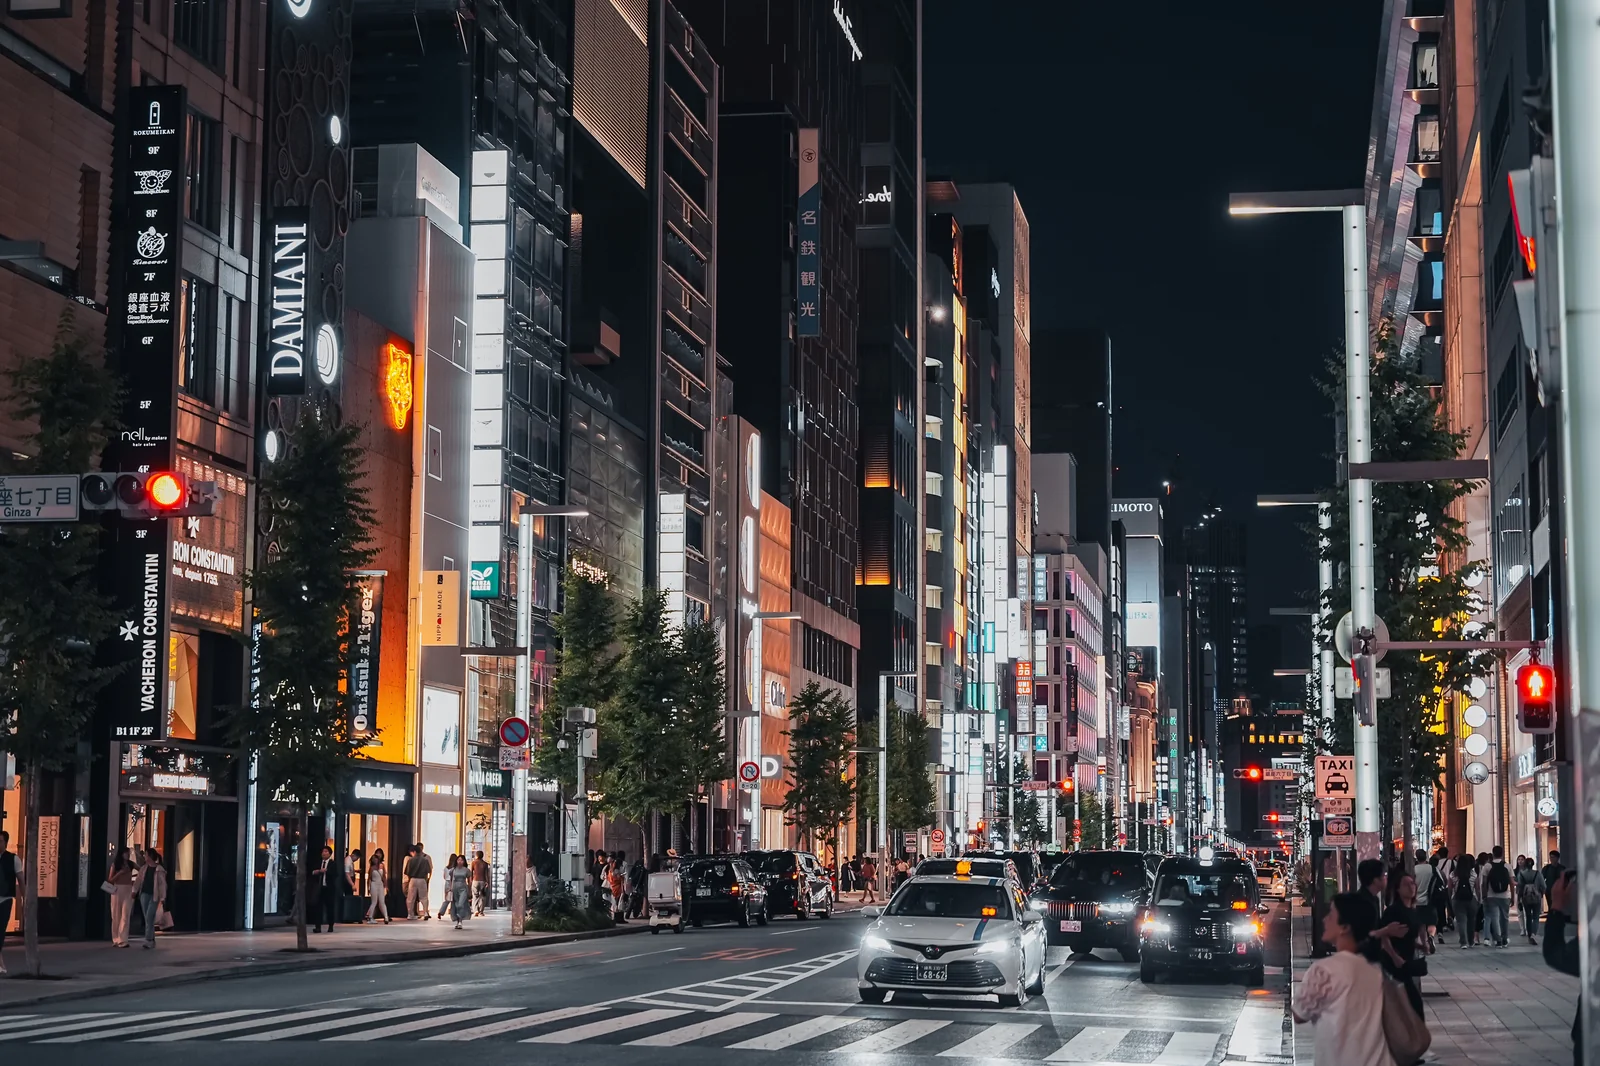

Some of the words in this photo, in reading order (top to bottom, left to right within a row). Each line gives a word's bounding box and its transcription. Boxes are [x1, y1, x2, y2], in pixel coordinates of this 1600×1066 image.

[148, 146, 160, 154] 9F
[146, 209, 158, 218] 8F
[800, 210, 816, 317] 名鉄観光
[143, 272, 156, 281] 7F
[127, 292, 171, 303] 銀座血液
[271, 223, 307, 377] DAMIANI
[127, 302, 170, 313] 検査ラボ
[141, 336, 154, 345] 6F
[140, 400, 152, 409] 5F
[121, 427, 145, 441] nell
[137, 465, 150, 473] 4F
[4, 507, 31, 517] Ginza
[35, 507, 41, 517] 7
[135, 530, 147, 538] 3F
[190, 545, 234, 575] CONSTANTIN
[143, 553, 159, 636] CONSTANTIN
[140, 639, 156, 712] VACHERON
[116, 727, 127, 735] B1
[129, 727, 141, 735] 1F
[141, 727, 154, 735] 2F
[998, 734, 1007, 769] ヨシノヤ
[1320, 760, 1353, 770] TAXI
[486, 771, 502, 787] GREEN
[48, 838, 57, 875] OTSUKA
